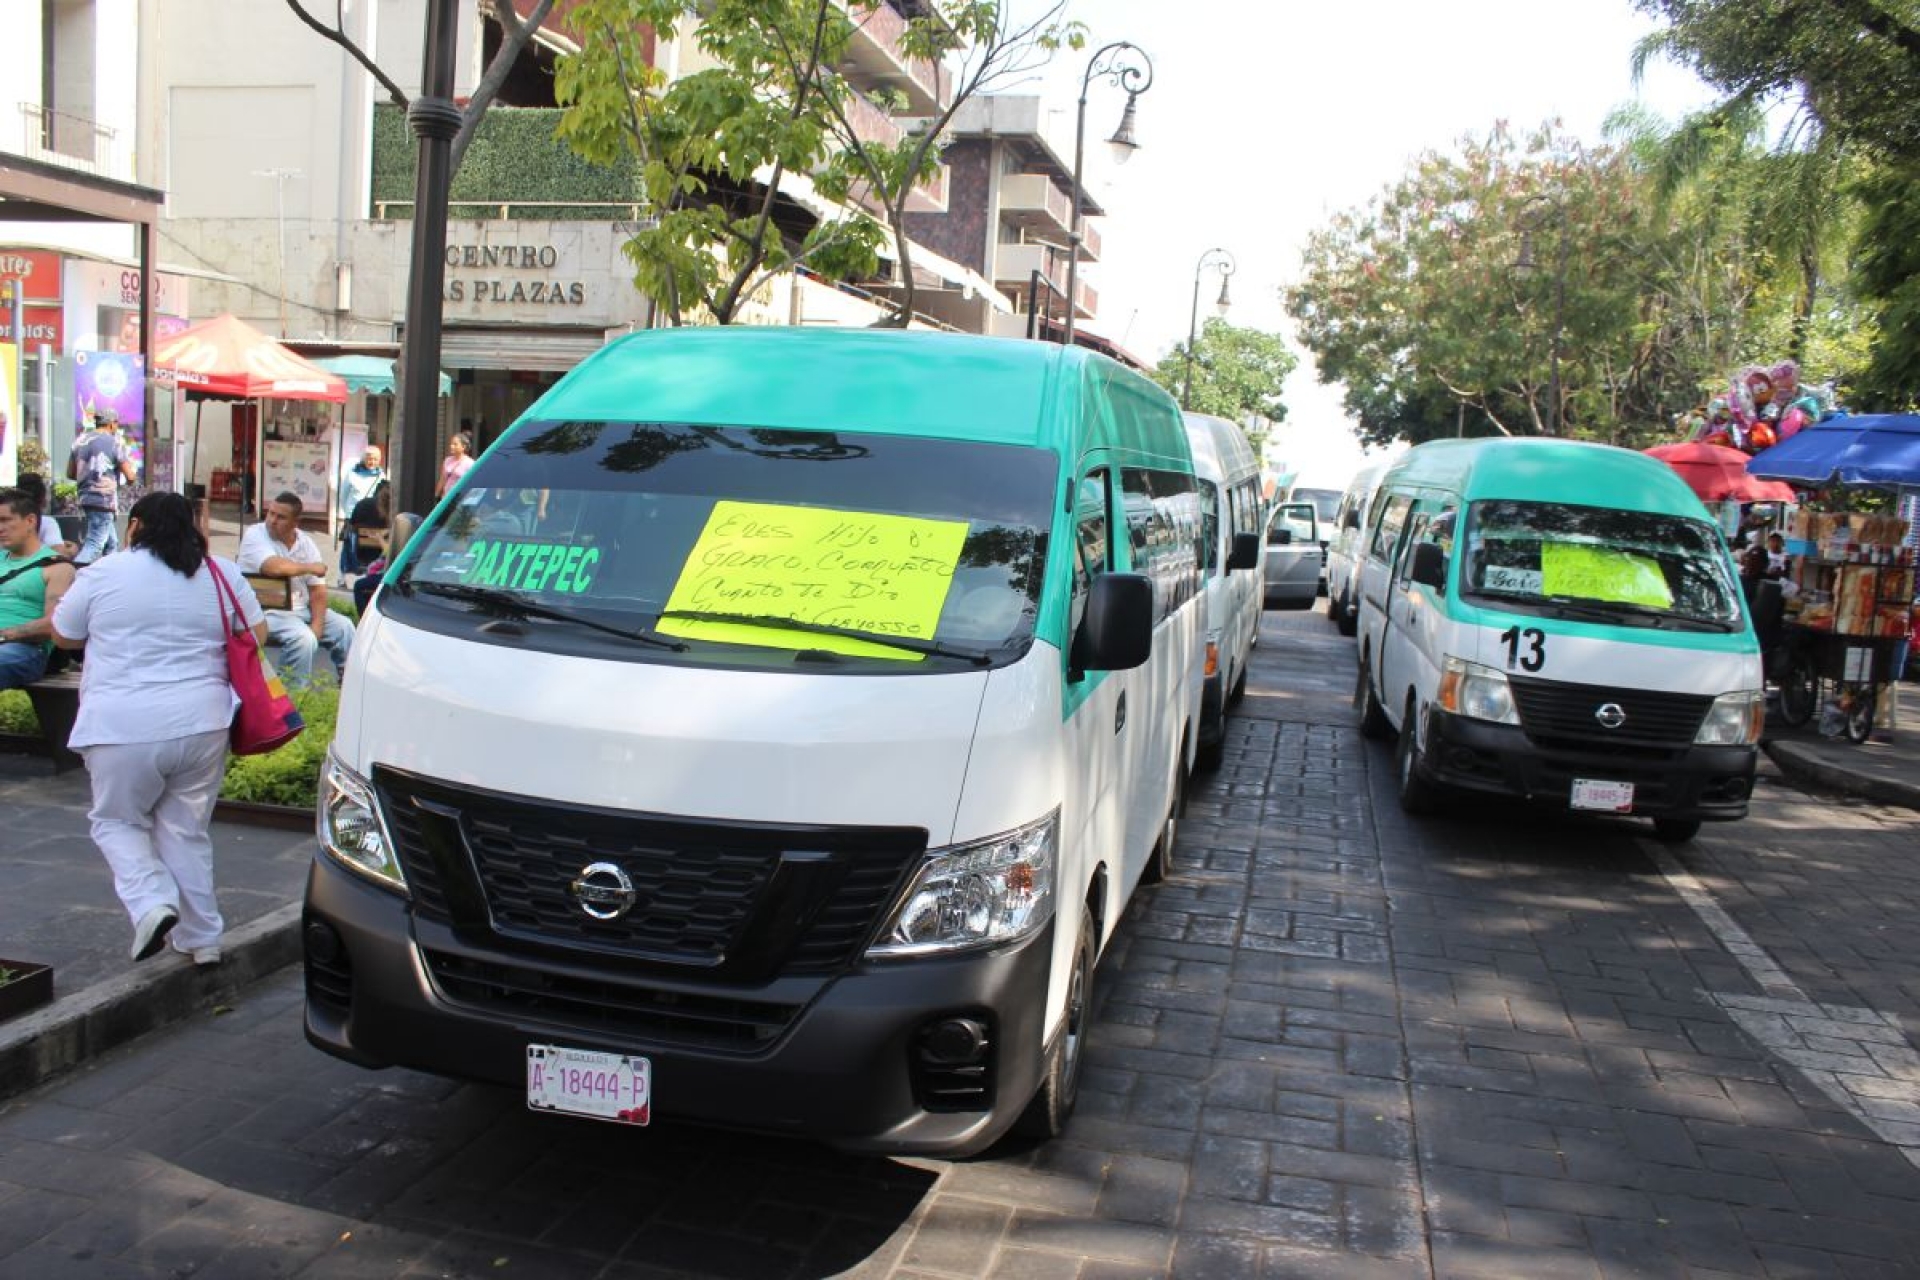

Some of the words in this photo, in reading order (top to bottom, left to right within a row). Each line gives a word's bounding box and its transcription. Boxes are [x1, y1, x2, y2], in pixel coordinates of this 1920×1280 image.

[445, 244, 558, 269] CENTRO
[473, 280, 586, 305] PLAZAS
[1500, 624, 1546, 673] 13
[532, 1062, 645, 1105] A-18444-P
